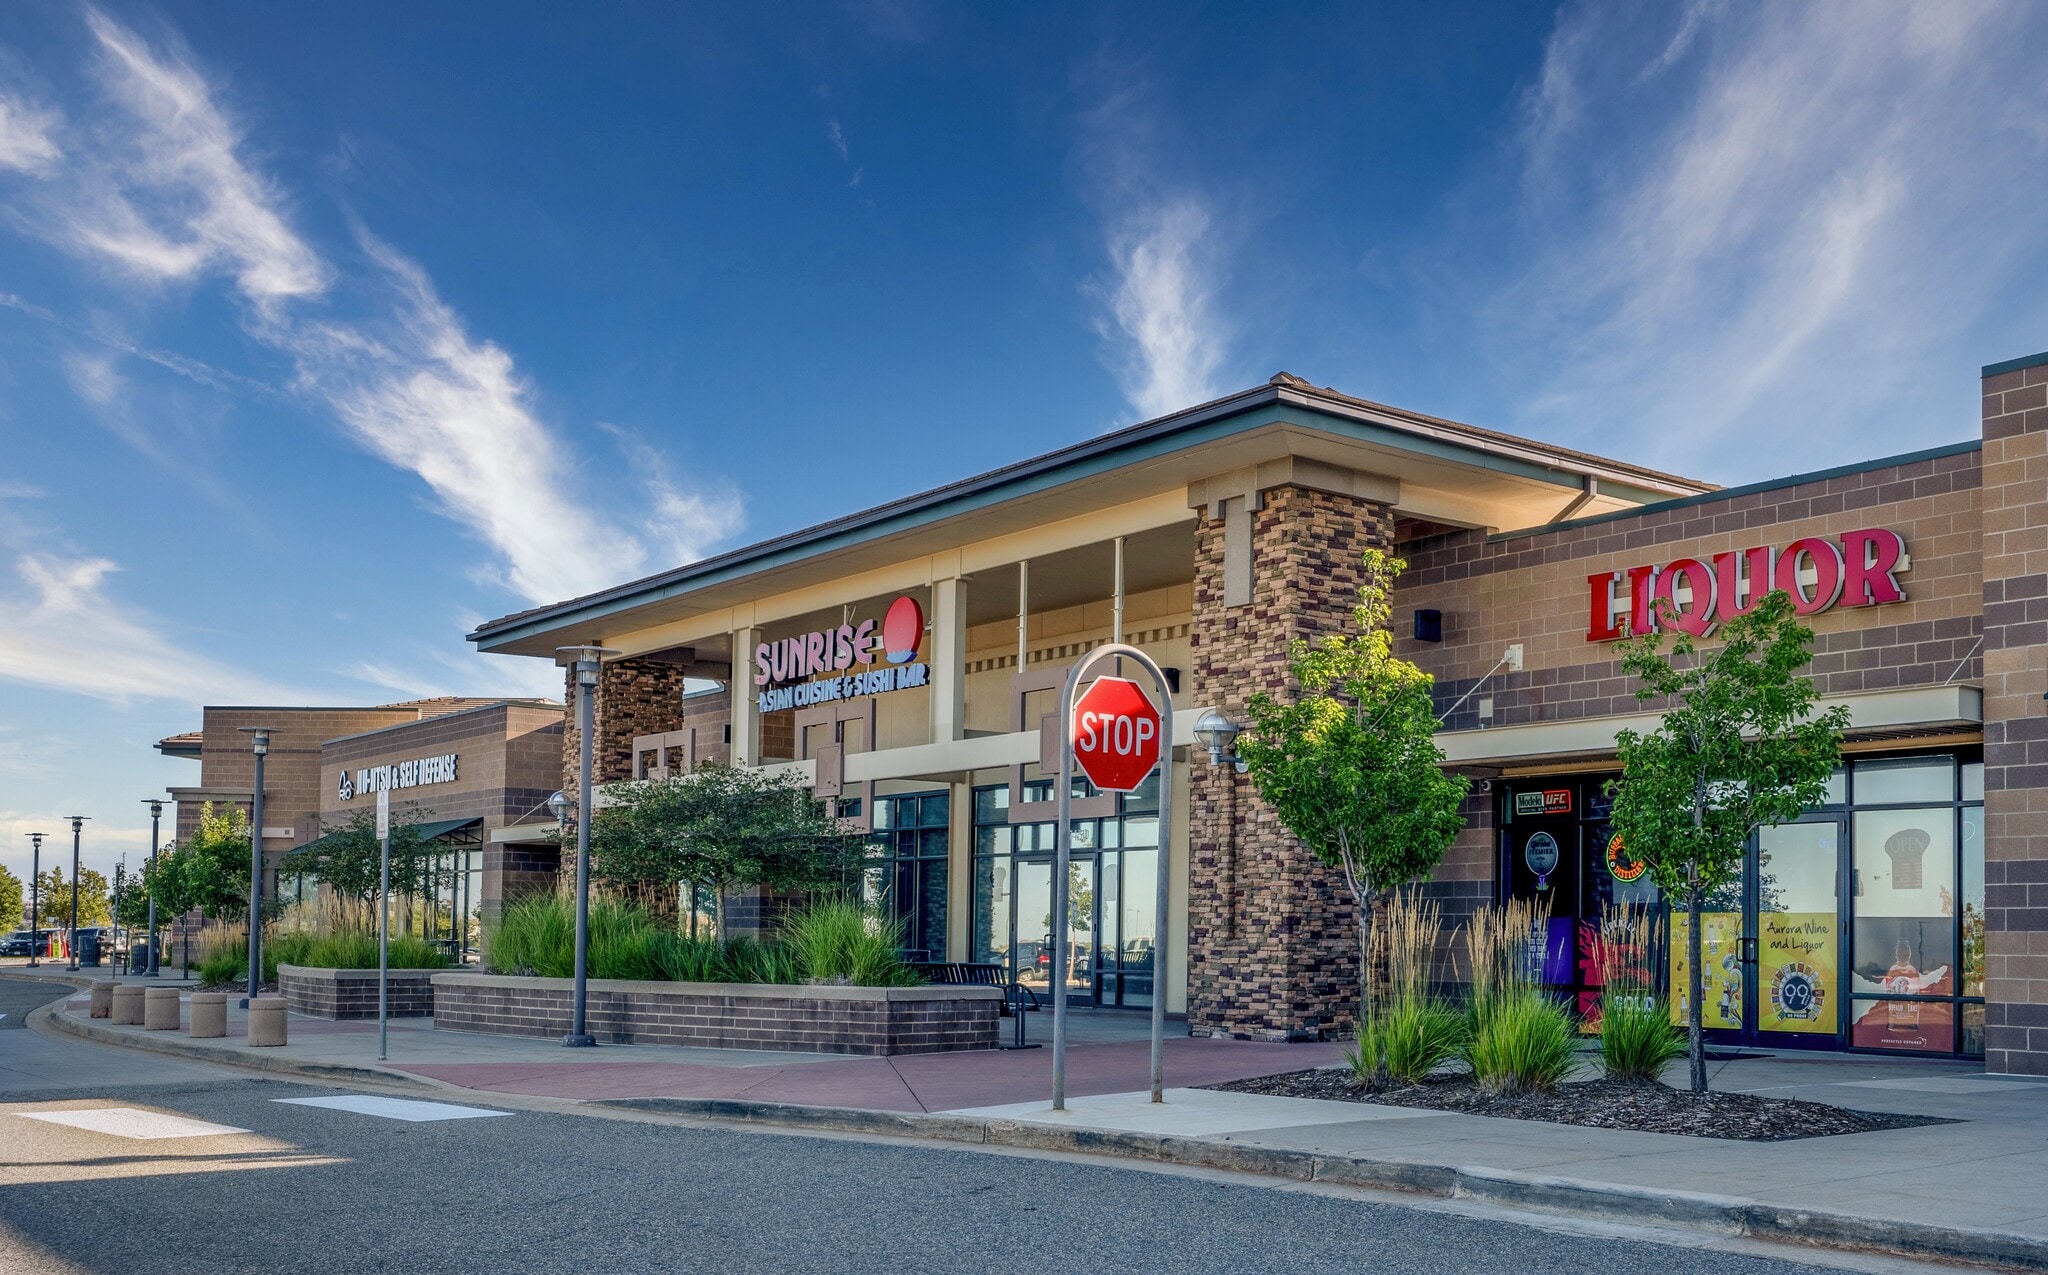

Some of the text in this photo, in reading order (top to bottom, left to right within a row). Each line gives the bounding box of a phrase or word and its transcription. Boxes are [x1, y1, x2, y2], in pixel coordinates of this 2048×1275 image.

[1587, 528, 1908, 642] LIQUOR
[754, 618, 877, 686] SUNRISE
[759, 663, 929, 713] ASIAN CUISINE & SUSHI BAR
[1079, 711, 1155, 756] STOP
[356, 754, 457, 795] JIU-JITSU & SELF DEFENSE
[1546, 793, 1567, 805] UFC
[1890, 836, 1925, 852] OPEN
[1767, 919, 1829, 934] Aurora Wine
[1770, 937, 1824, 955] and Liquor
[1784, 984, 1809, 1005] 99
